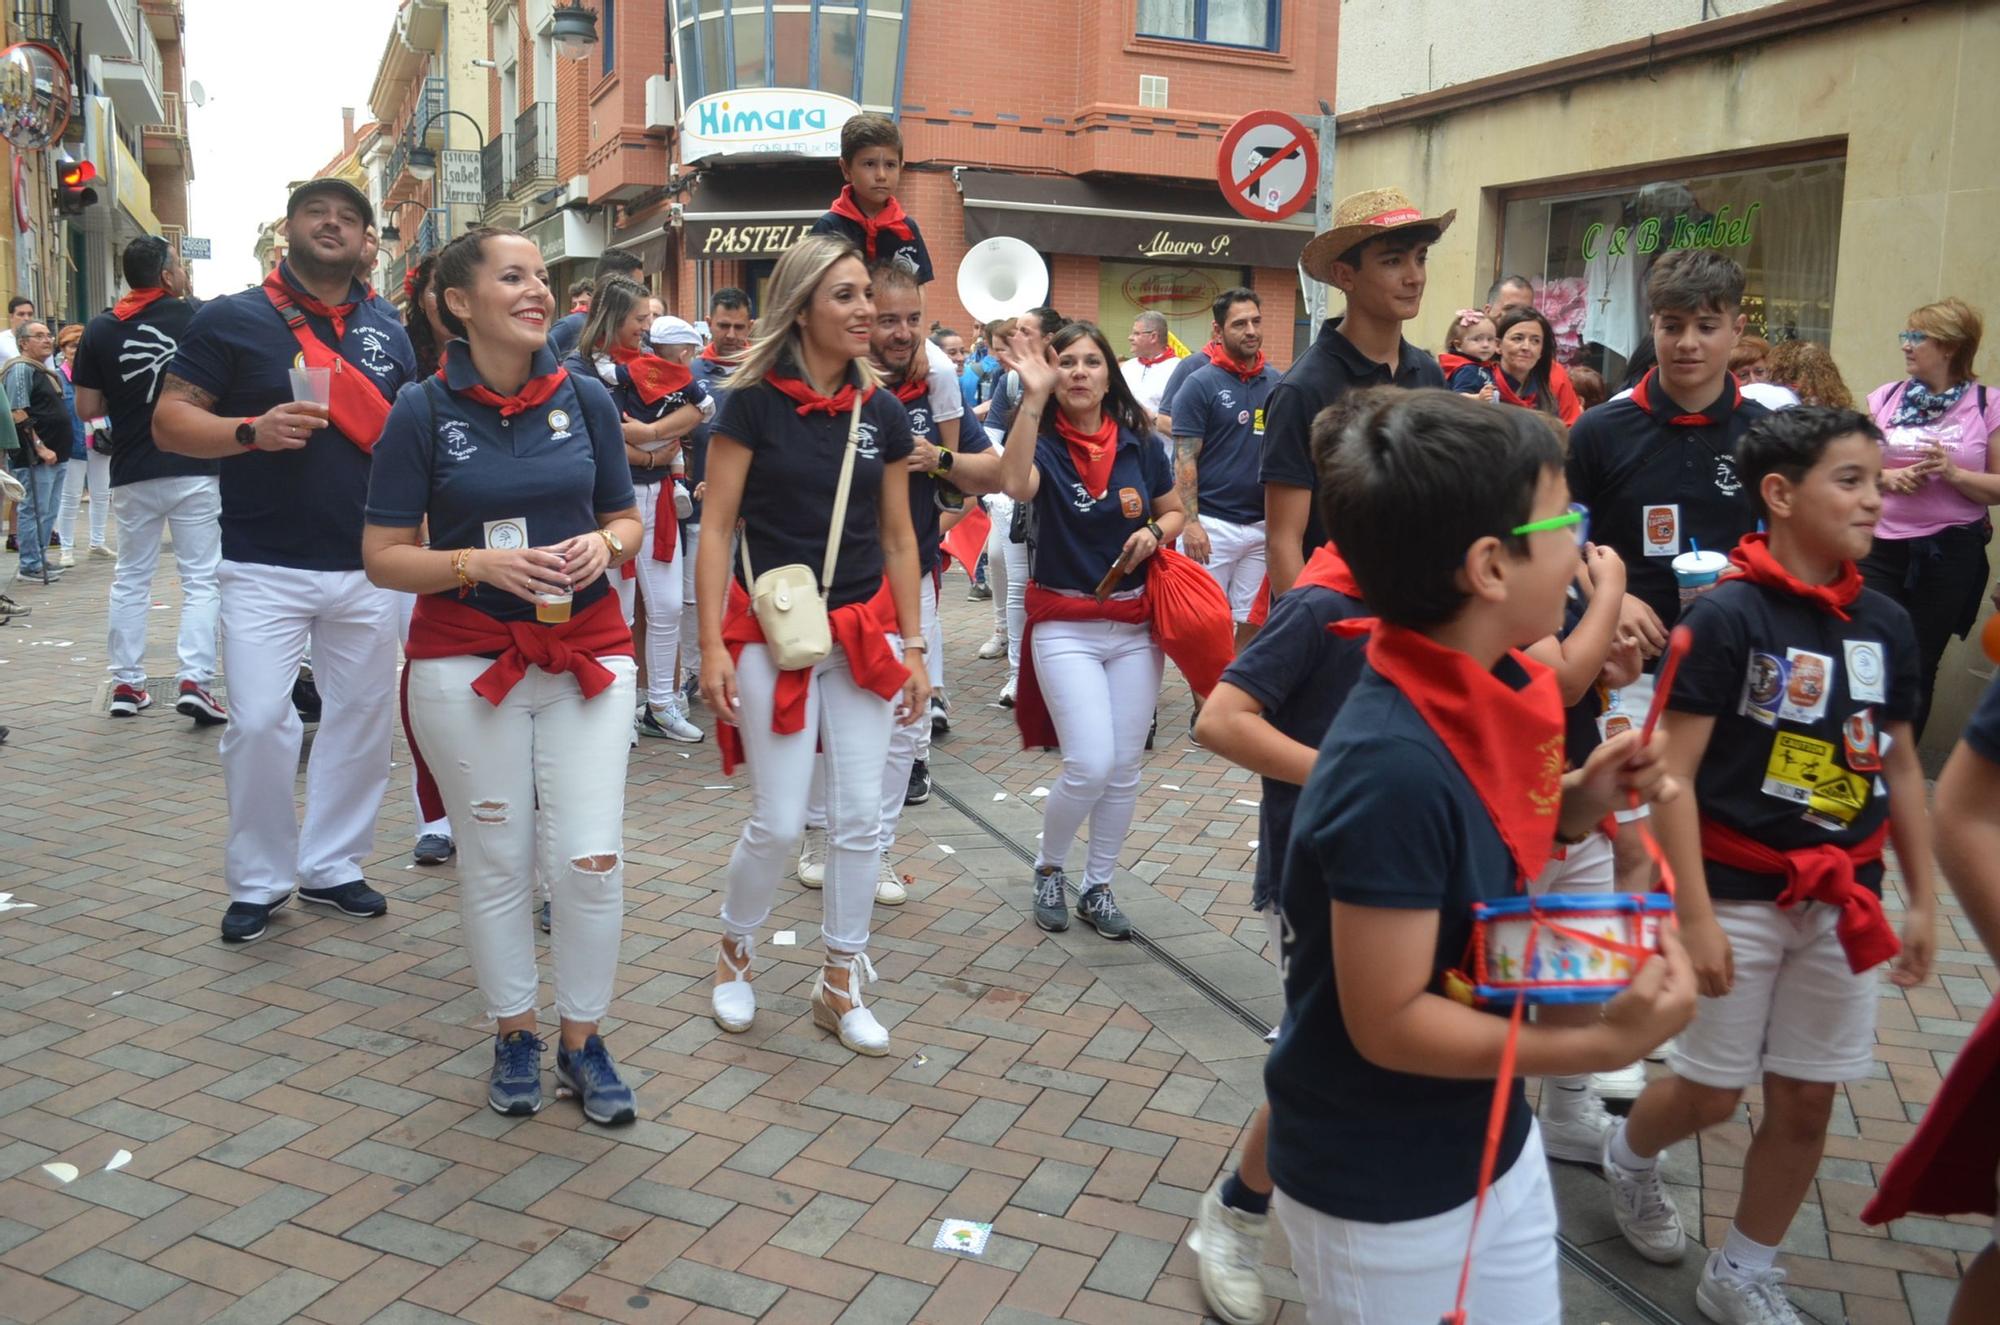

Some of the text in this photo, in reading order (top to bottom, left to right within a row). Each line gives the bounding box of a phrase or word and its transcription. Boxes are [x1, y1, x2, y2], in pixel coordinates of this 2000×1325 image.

[699, 101, 825, 135] Himara
[444, 152, 480, 163] ESTETICA
[825, 142, 841, 152] PSI
[1138, 230, 1231, 257] Alvaro P.
[1582, 201, 1760, 261] C & B Isabel
